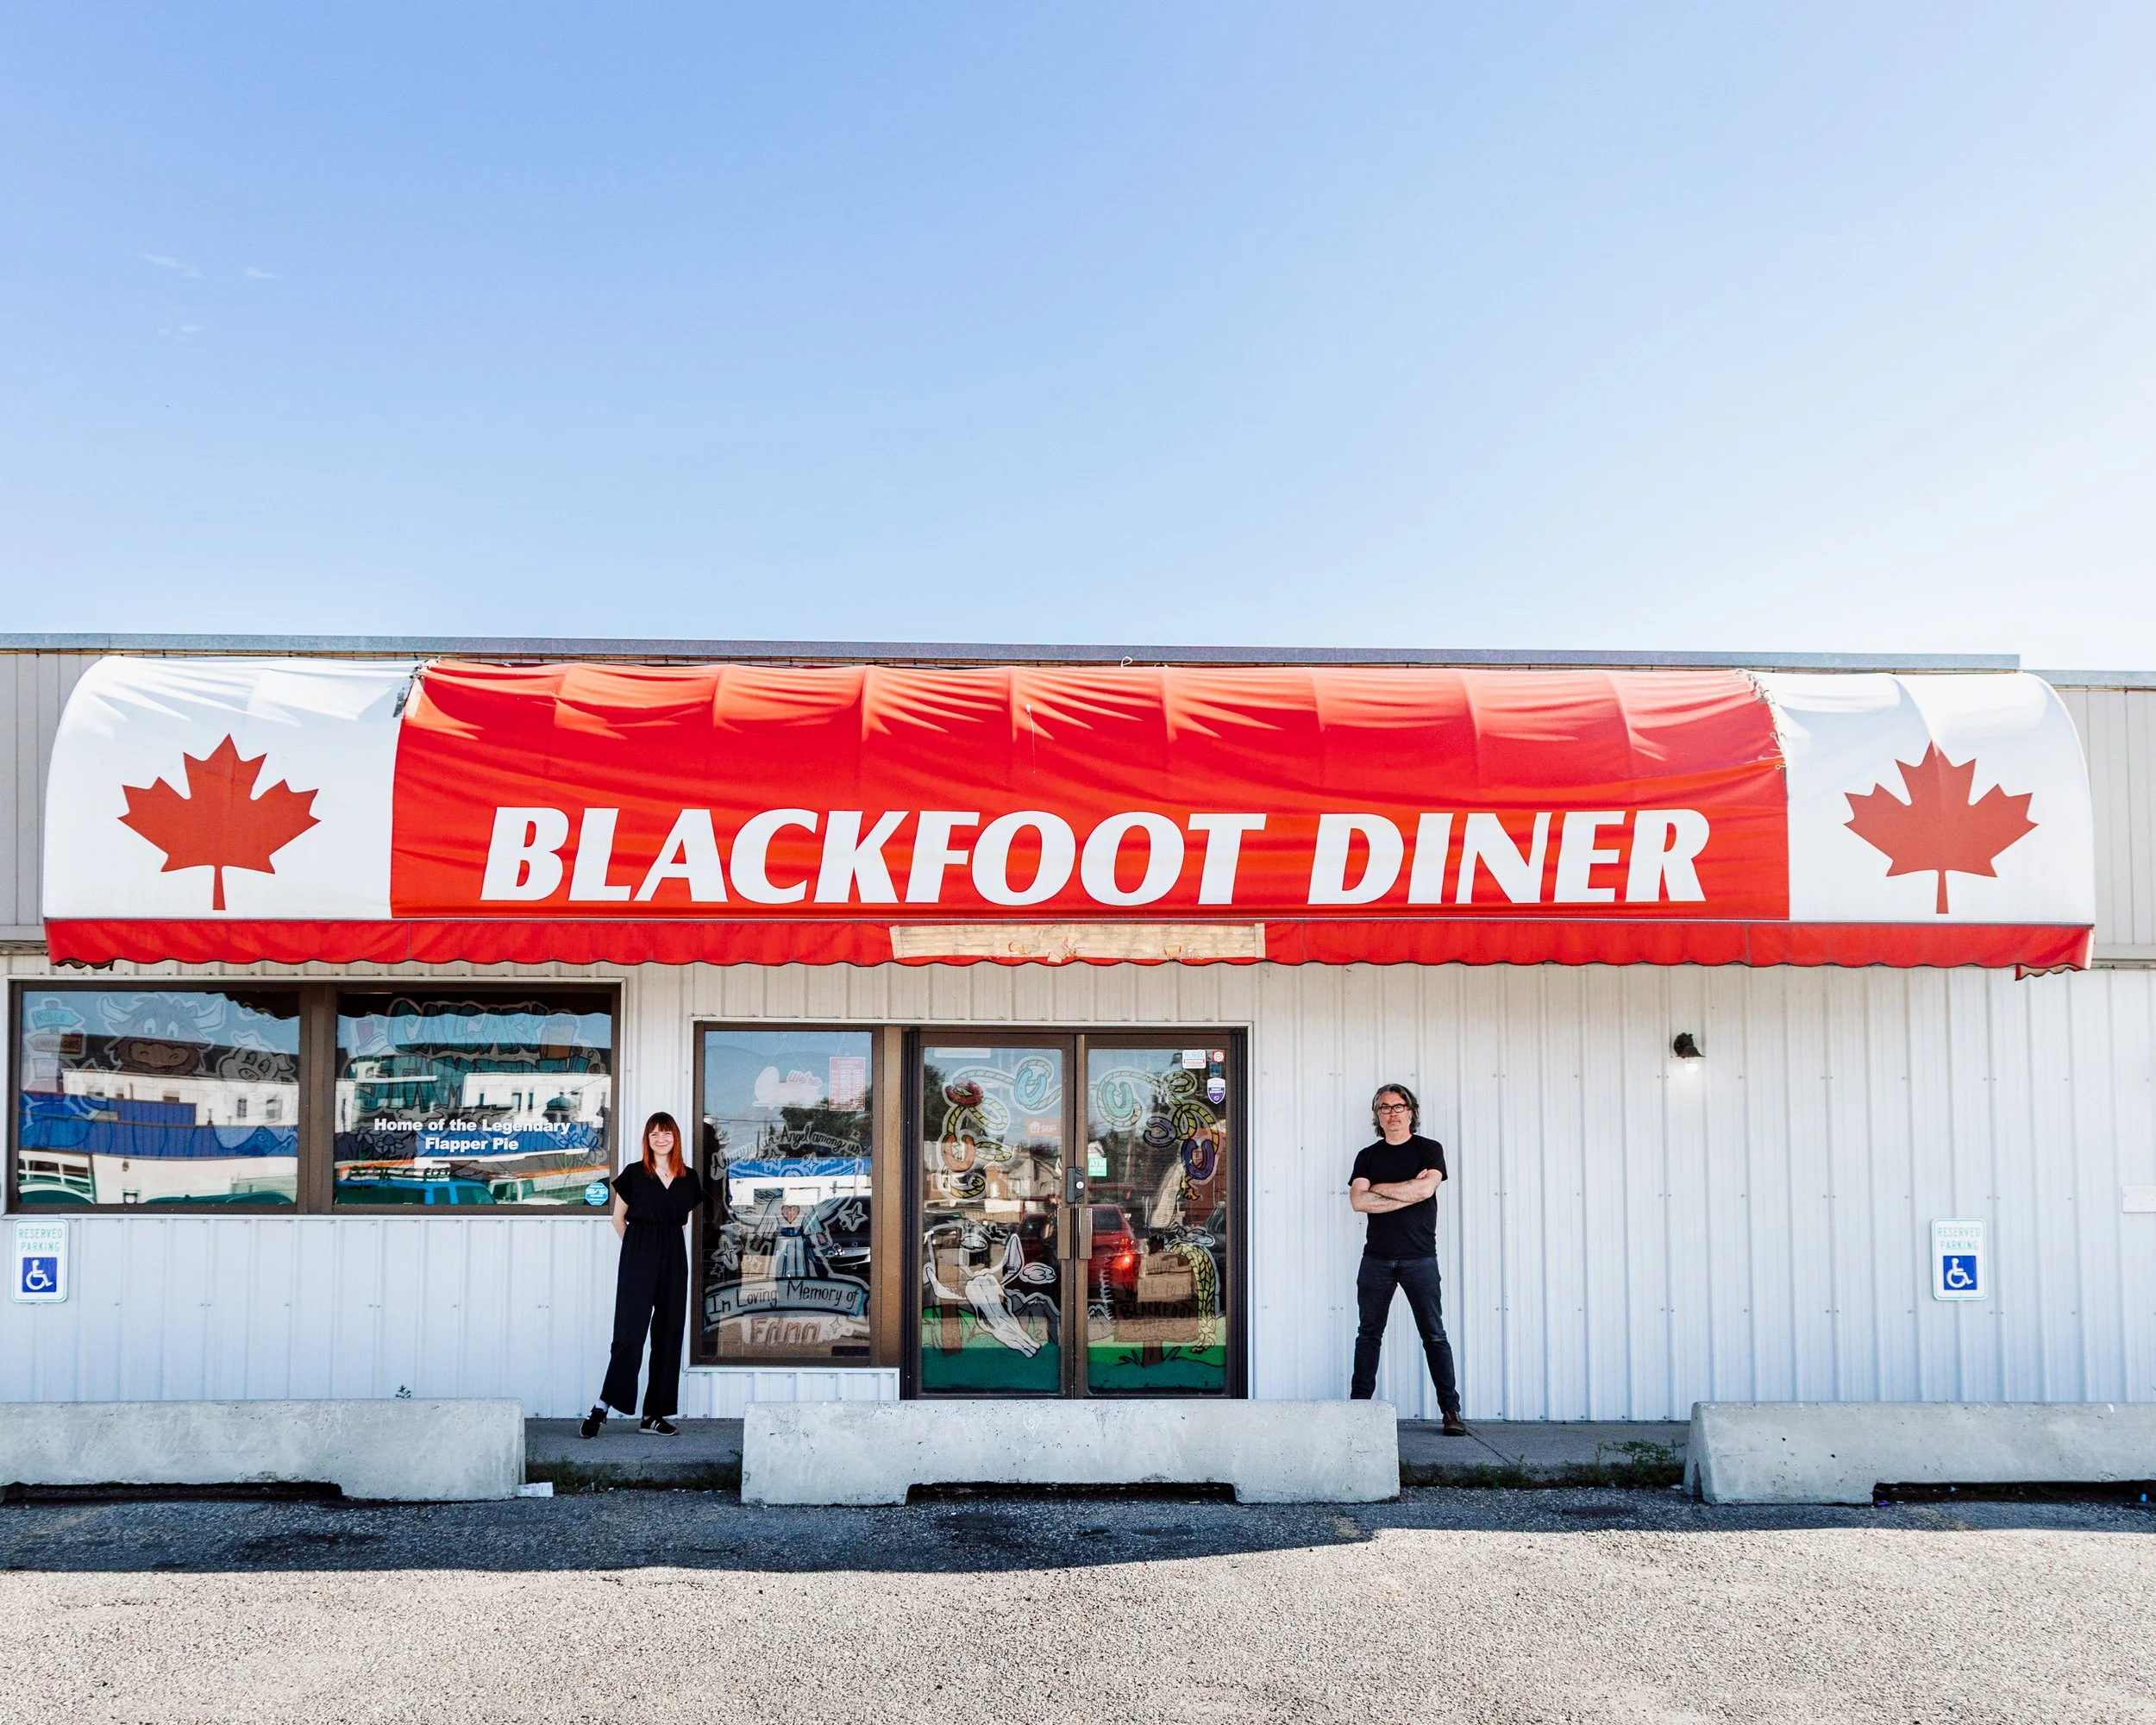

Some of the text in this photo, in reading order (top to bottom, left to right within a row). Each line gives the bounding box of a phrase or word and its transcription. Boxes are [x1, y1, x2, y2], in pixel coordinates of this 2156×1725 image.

[479, 806, 1710, 906] BLACKFOOT DINER
[390, 1000, 549, 1055] CALGARY
[374, 1119, 571, 1135] Home of the Legendary
[425, 1137, 519, 1152] Flapper Pie
[712, 1123, 861, 1171] Always an Angel among us
[1089, 1158, 1105, 1167] ATM
[18, 1228, 63, 1239] RESERVED
[1938, 1227, 1981, 1238] RESERVED
[21, 1242, 60, 1252] PARKING
[1940, 1240, 1978, 1251] PARKING
[707, 1280, 860, 1314] In Loving Memory of
[749, 1316, 822, 1346] Edna
